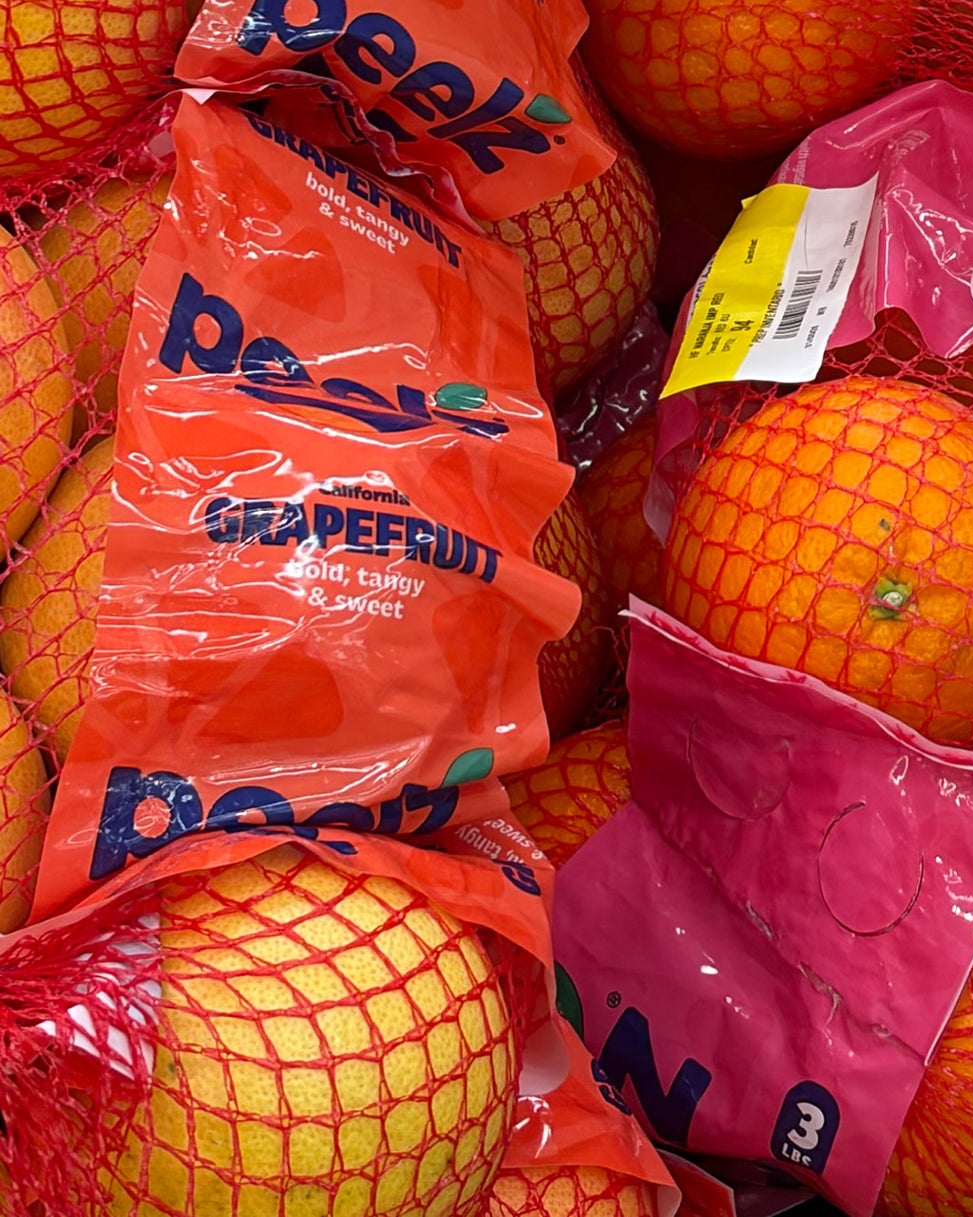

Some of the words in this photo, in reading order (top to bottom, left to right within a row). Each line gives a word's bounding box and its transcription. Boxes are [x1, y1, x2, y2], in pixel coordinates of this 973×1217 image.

[247, 116, 463, 269] GRAPEFRUIT
[305, 171, 351, 213] bold,
[356, 205, 410, 246] tangy
[318, 201, 334, 219] &
[338, 214, 396, 255] sweet
[319, 482, 411, 506] California
[204, 496, 503, 584] GRAPEFRUIT
[307, 586, 328, 607] &
[334, 592, 405, 620] sweet
[356, 567, 426, 598] tangy
[786, 1101, 826, 1151] 3
[780, 1142, 813, 1168] LBS
